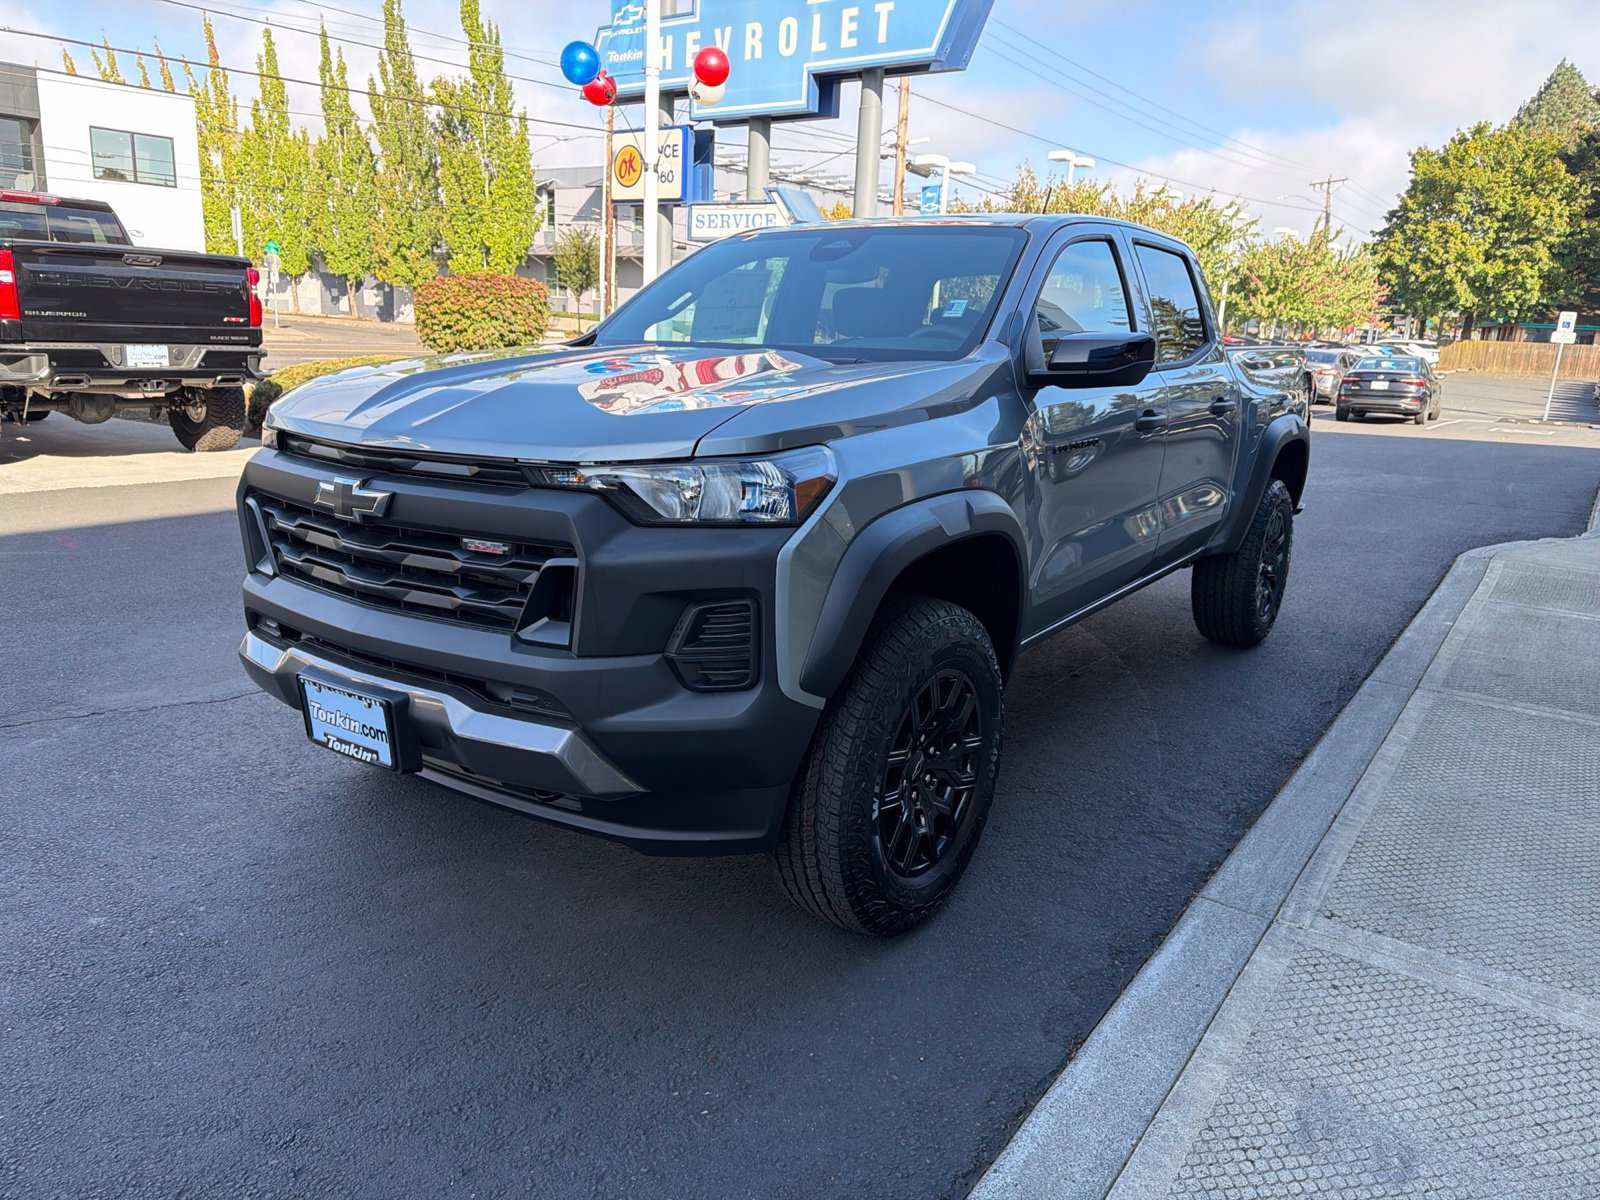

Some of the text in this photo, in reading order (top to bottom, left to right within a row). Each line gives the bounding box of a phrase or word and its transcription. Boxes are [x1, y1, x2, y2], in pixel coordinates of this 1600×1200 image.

[610, 26, 645, 37] EVROLET
[658, 2, 895, 71] HEVROLET
[608, 49, 643, 63] Tonkin
[657, 143, 679, 159] NCE
[618, 152, 637, 179] OK
[657, 169, 675, 183] 60
[695, 213, 777, 229] SERVICE
[37, 273, 237, 295] CHEVROLET
[310, 700, 389, 744] Tonkin.com
[327, 734, 372, 763] Tonkin
